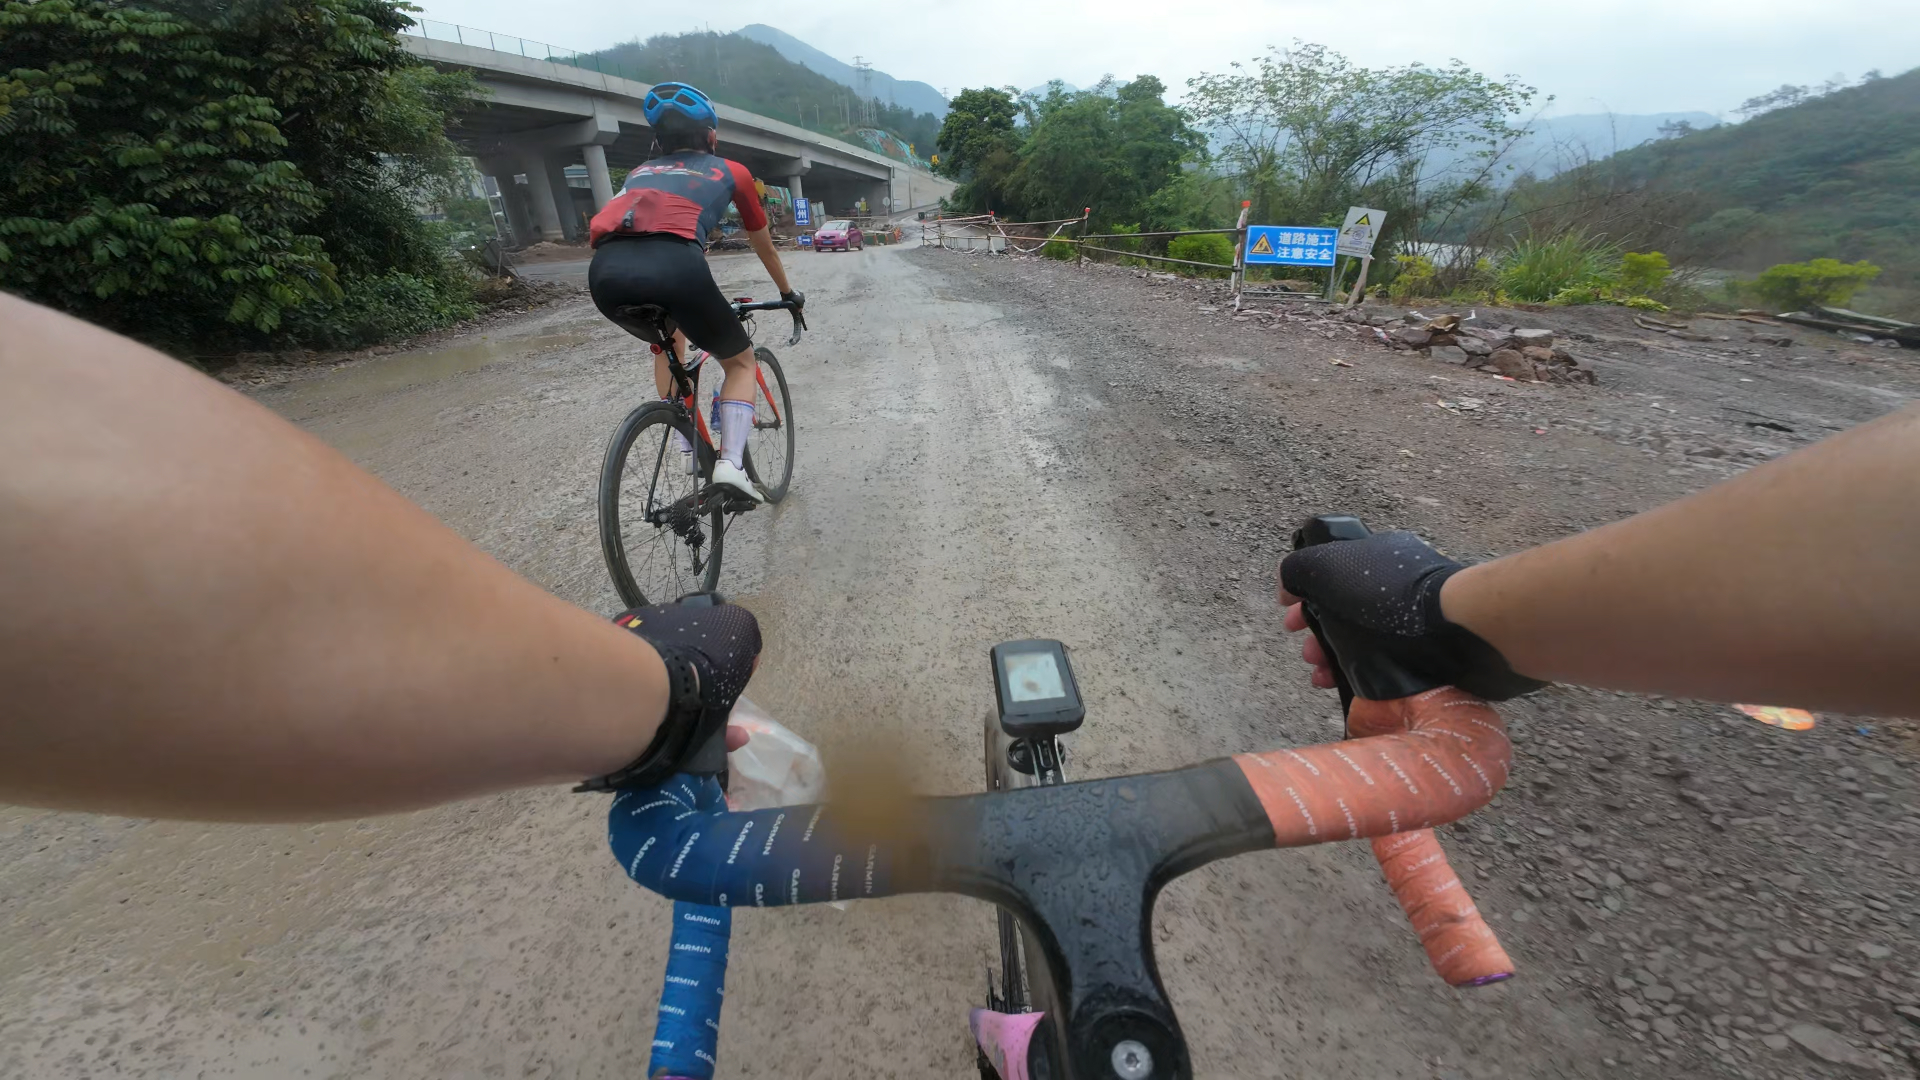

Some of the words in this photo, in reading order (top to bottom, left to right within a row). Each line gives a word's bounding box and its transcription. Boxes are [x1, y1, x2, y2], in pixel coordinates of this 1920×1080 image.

[796, 199, 807, 219] 福州
[1277, 246, 1333, 260] 注意安全
[1278, 231, 1333, 246] 道路施工
[1380, 752, 1419, 795] GARMIN
[1422, 752, 1462, 796] GARMIN
[1285, 786, 1317, 836] GARMIN
[669, 832, 701, 879] GARMIN
[727, 820, 754, 864] GARMIN
[762, 813, 785, 856] GARMIN
[864, 843, 877, 895] GARMIN
[683, 912, 721, 926] GARMIN
[674, 943, 712, 954] GARMIN
